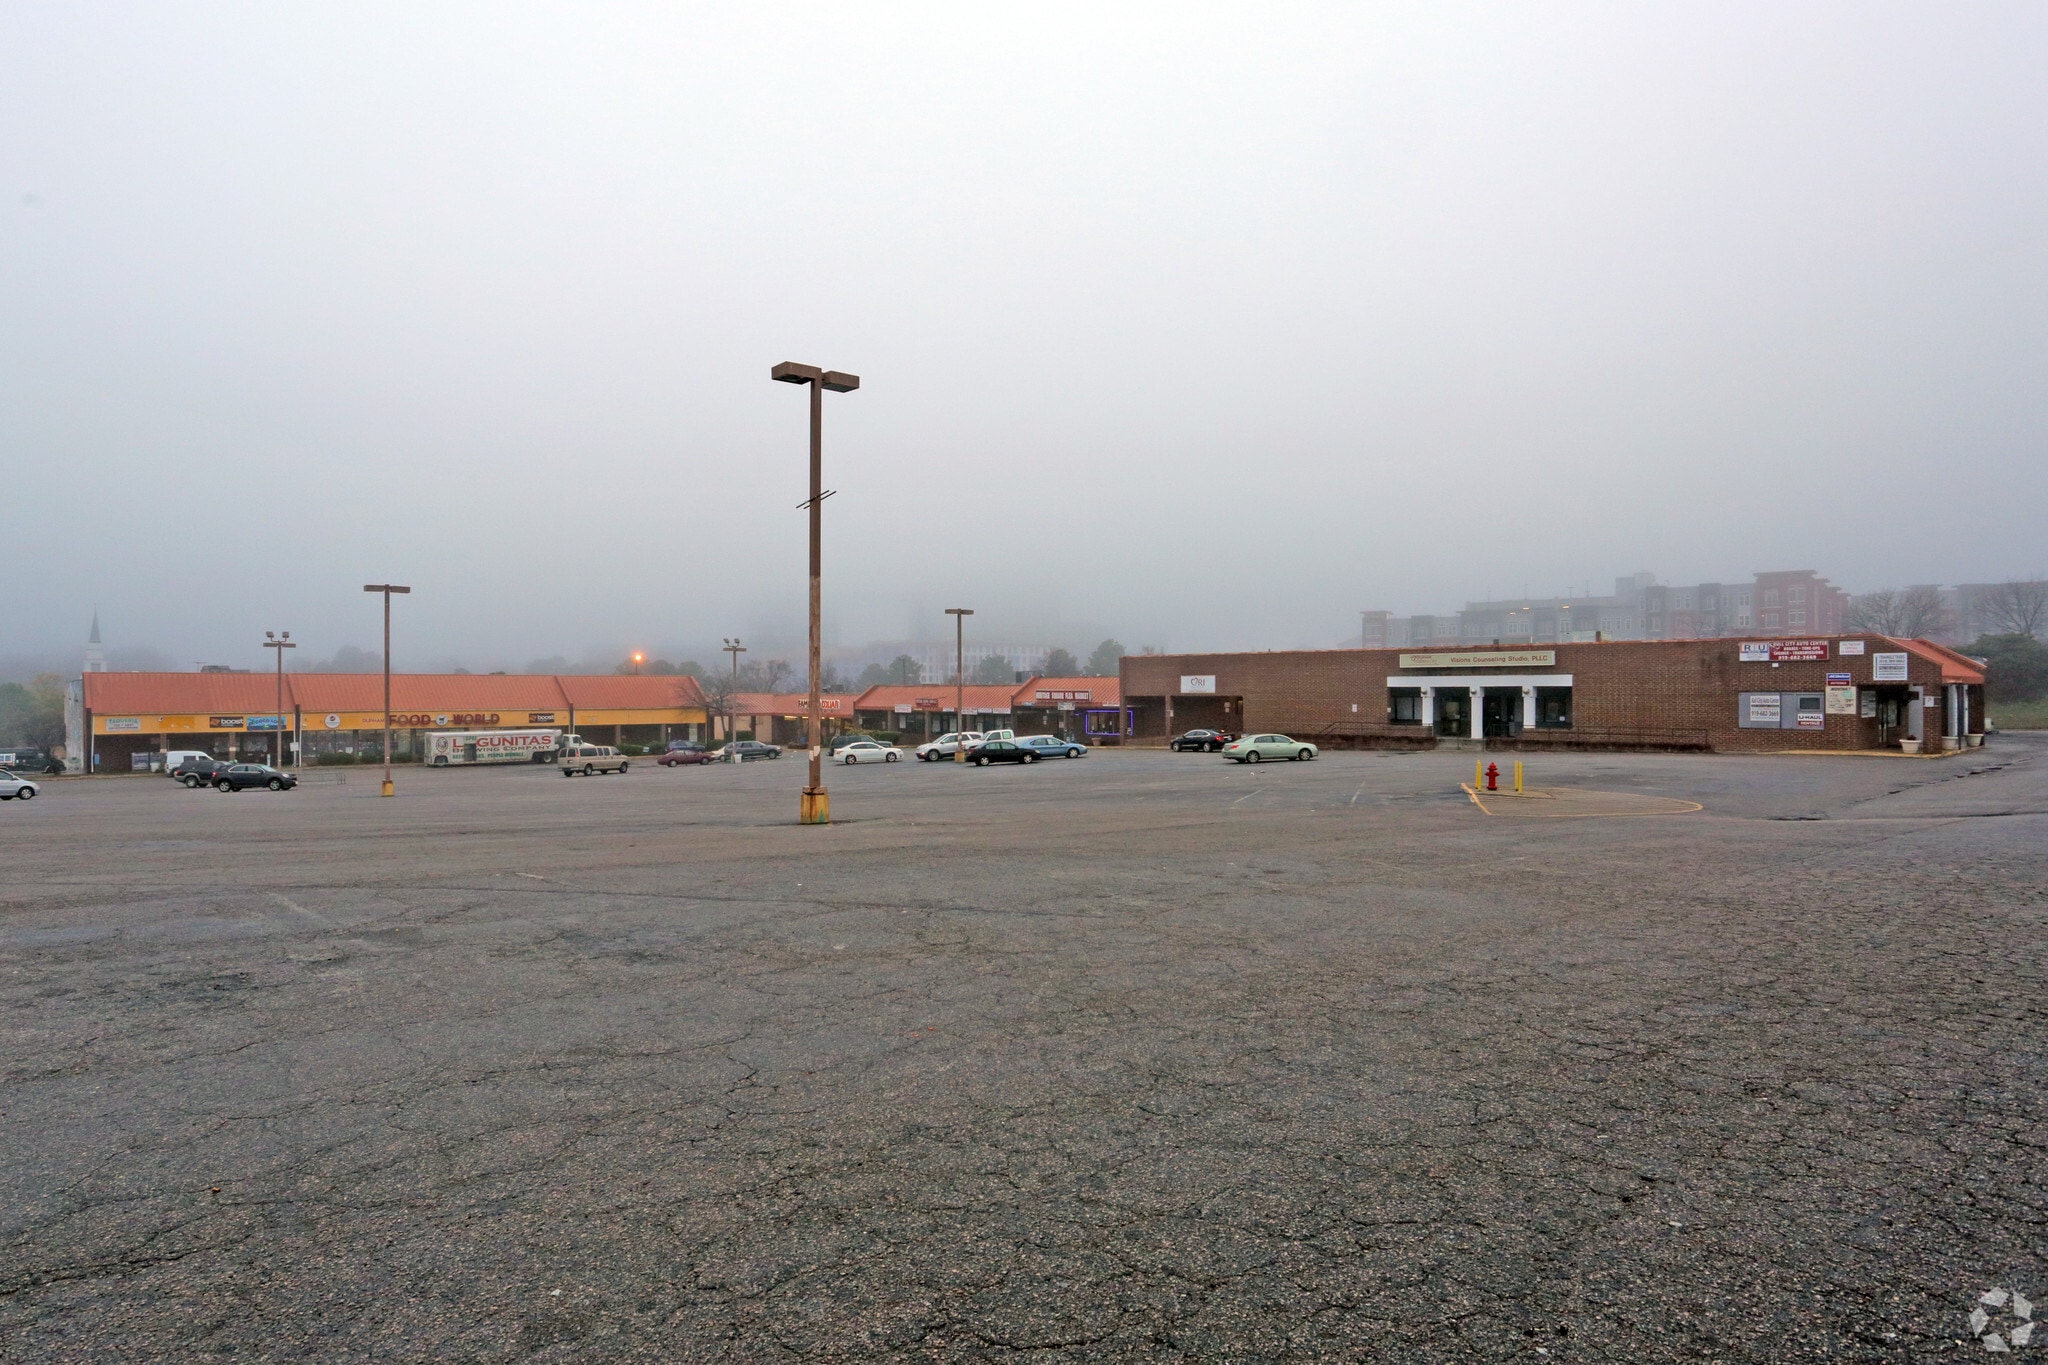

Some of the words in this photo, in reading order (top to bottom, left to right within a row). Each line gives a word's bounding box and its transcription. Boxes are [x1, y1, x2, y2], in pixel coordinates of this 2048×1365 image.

[389, 714, 431, 726] FOOD
[452, 714, 500, 725] WORLD
[452, 736, 552, 748] LGUNITAS
